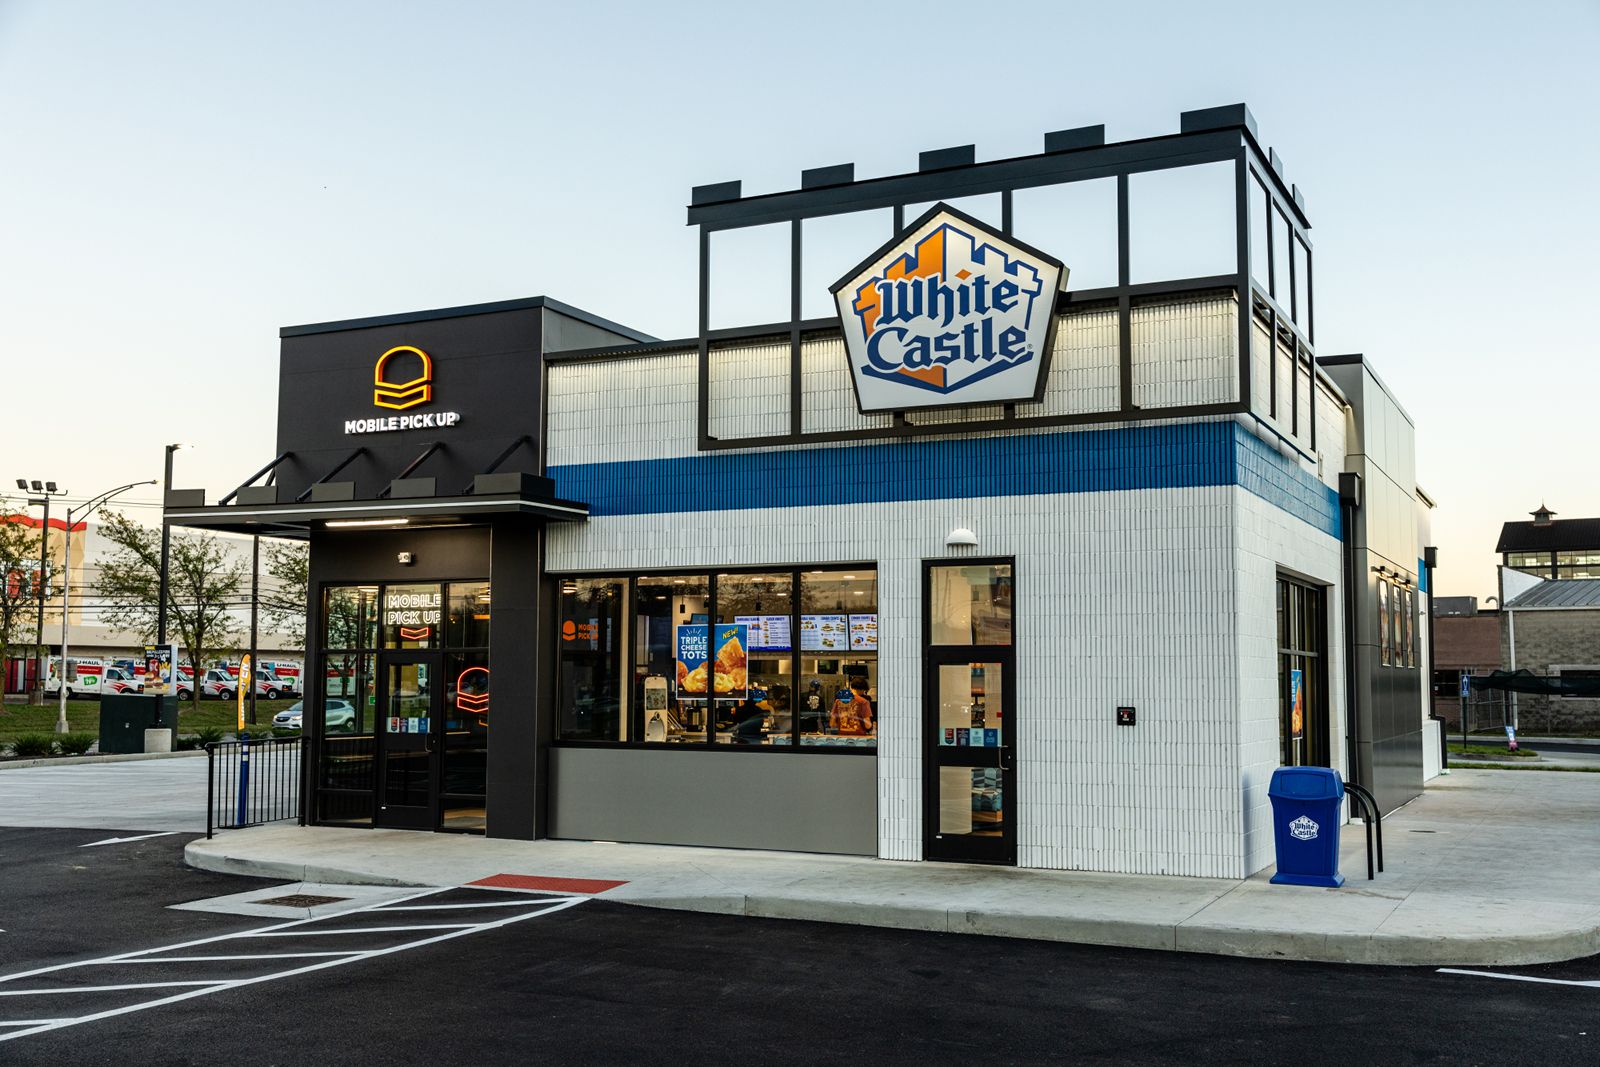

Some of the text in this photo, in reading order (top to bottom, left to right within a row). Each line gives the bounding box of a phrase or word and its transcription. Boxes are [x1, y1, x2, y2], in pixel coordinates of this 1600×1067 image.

[875, 269, 1019, 328] White
[867, 316, 1026, 371] Castle
[344, 411, 459, 434] MOBILE PICK UP
[388, 594, 441, 608] MOBILE
[387, 610, 441, 625] PICK UP
[680, 636, 708, 645] TRIPLE
[681, 651, 708, 660] TOTS
[1294, 822, 1315, 831] White
